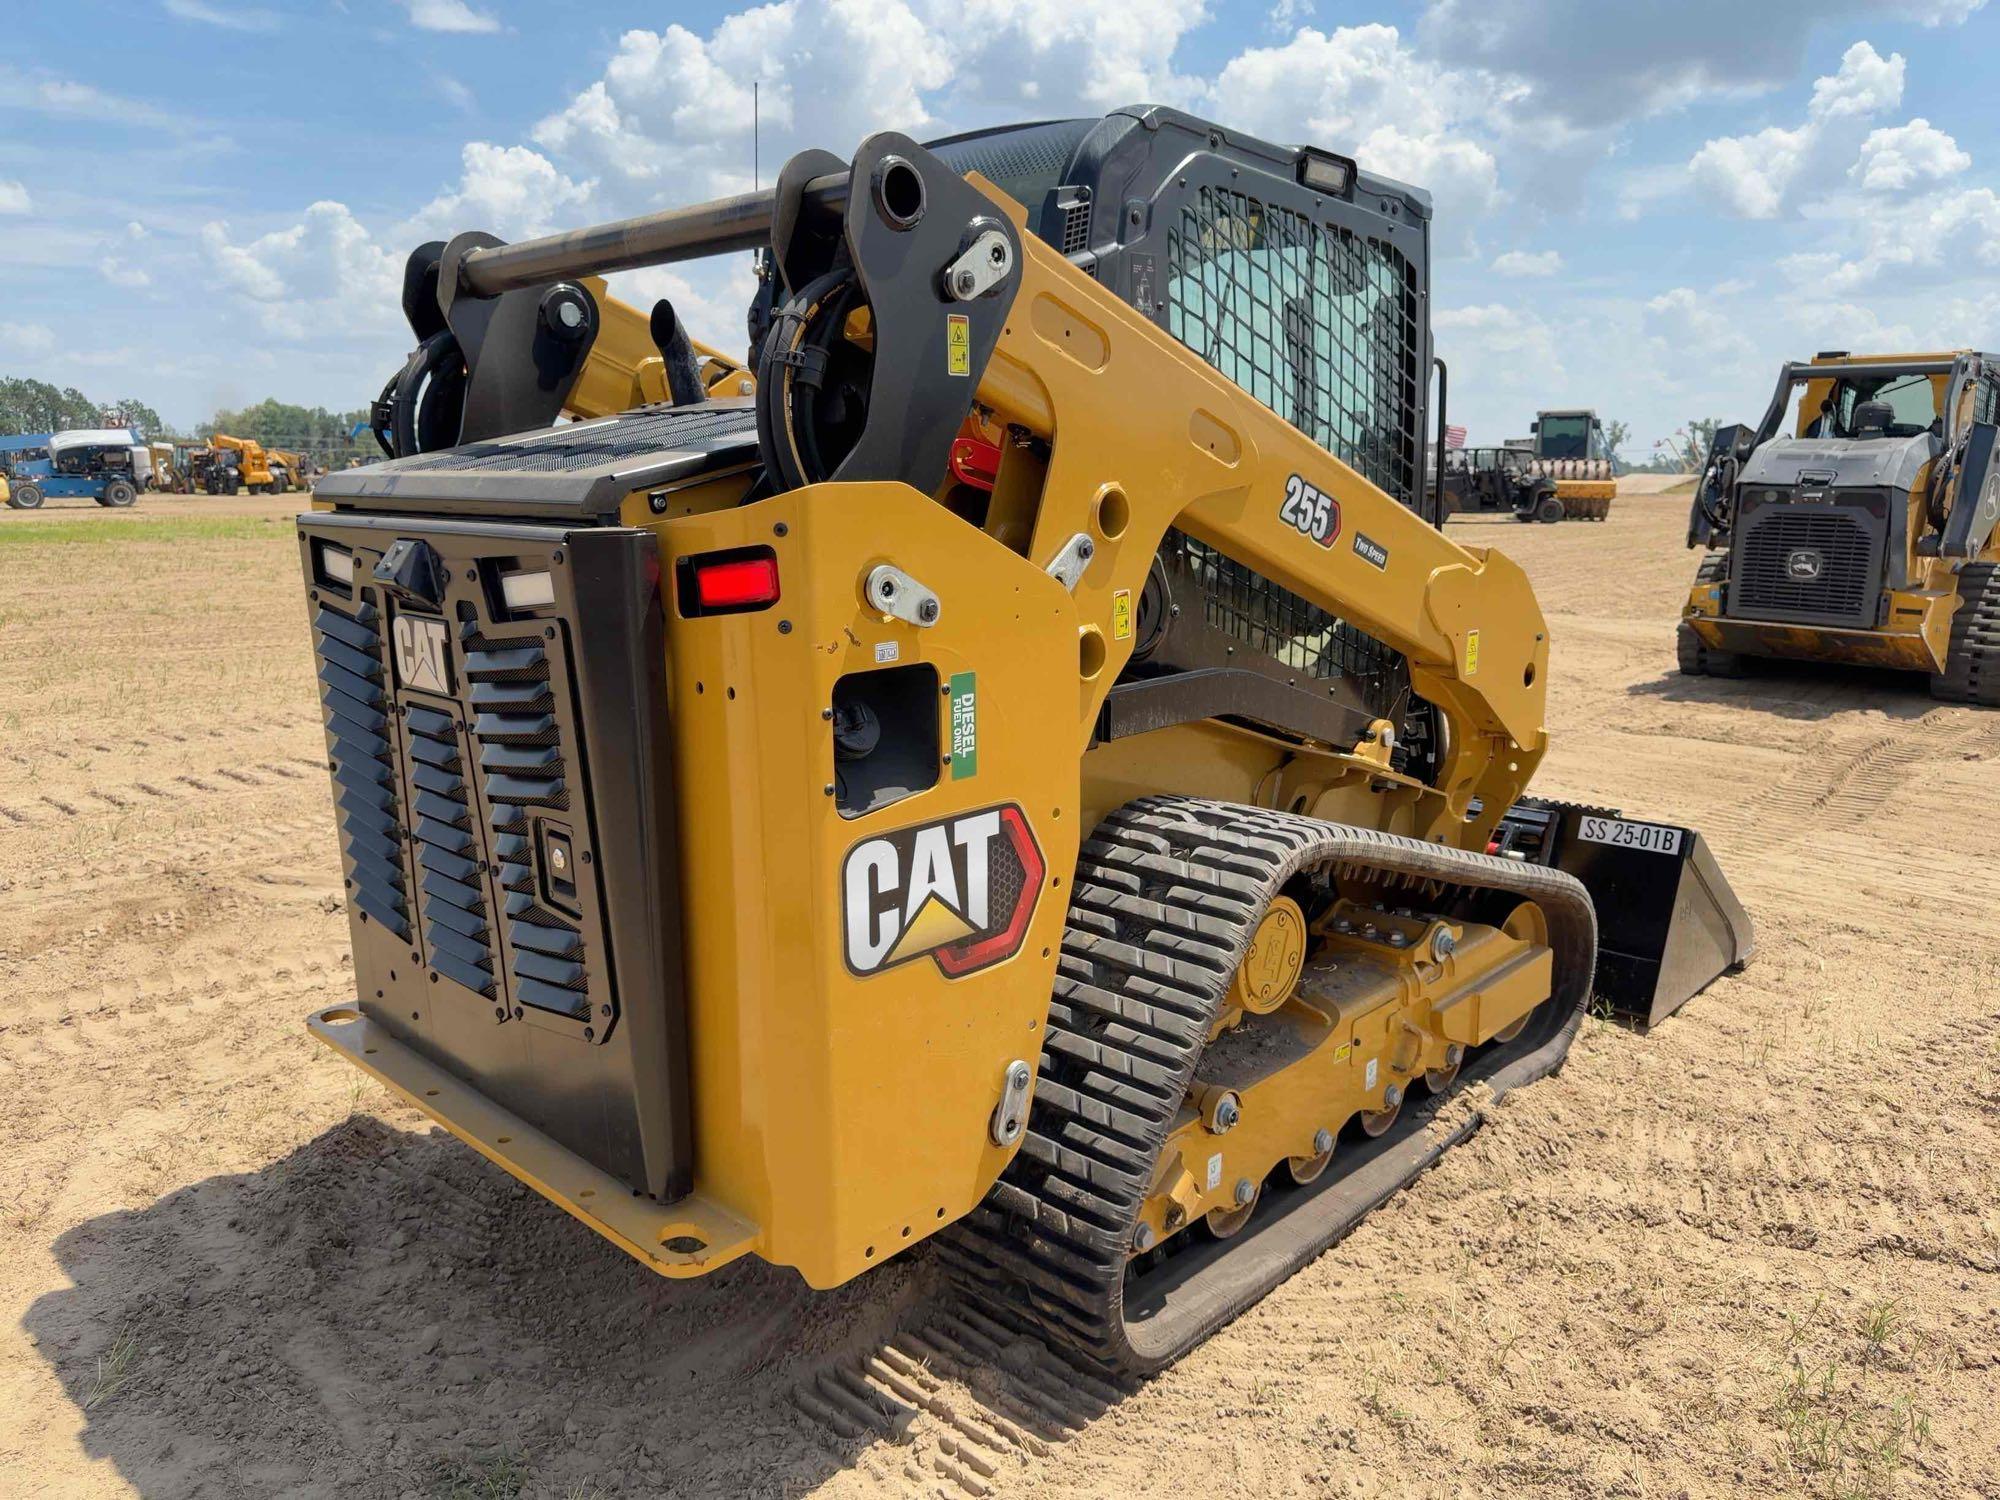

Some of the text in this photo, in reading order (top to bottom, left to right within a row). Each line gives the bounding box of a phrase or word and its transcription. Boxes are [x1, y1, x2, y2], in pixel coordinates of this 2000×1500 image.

[1281, 475, 1331, 539] 255
[393, 616, 448, 694] CAT
[953, 698, 963, 756] FUEL ONLY
[961, 693, 975, 758] DIESEL
[1584, 819, 1675, 851] SS 25-01B
[846, 811, 1000, 971] CAT
